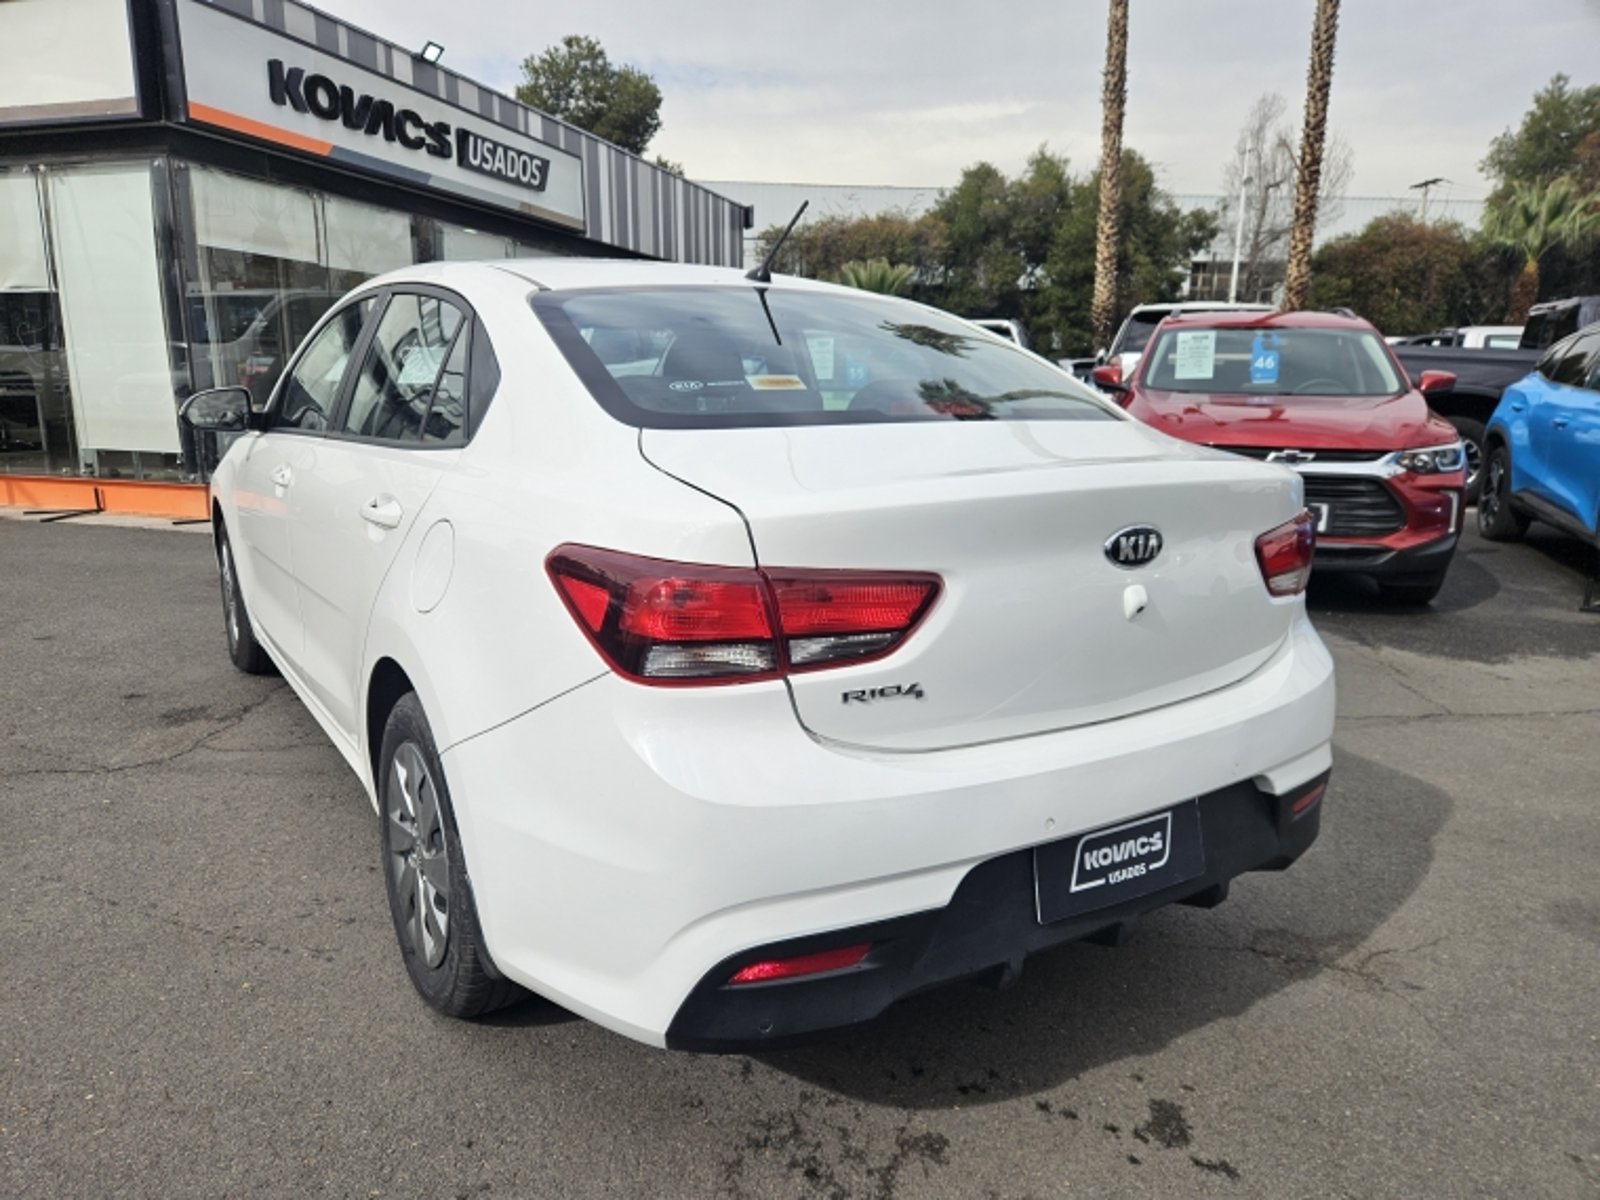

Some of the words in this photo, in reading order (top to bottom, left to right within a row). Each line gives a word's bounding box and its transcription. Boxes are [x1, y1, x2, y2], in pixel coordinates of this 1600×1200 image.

[267, 58, 452, 159] KOVACS
[468, 133, 542, 186] USADOS
[1254, 355, 1275, 369] 46
[1118, 534, 1158, 561] KIA
[1084, 831, 1163, 870] KOVACS
[1108, 863, 1147, 884] USADOS
